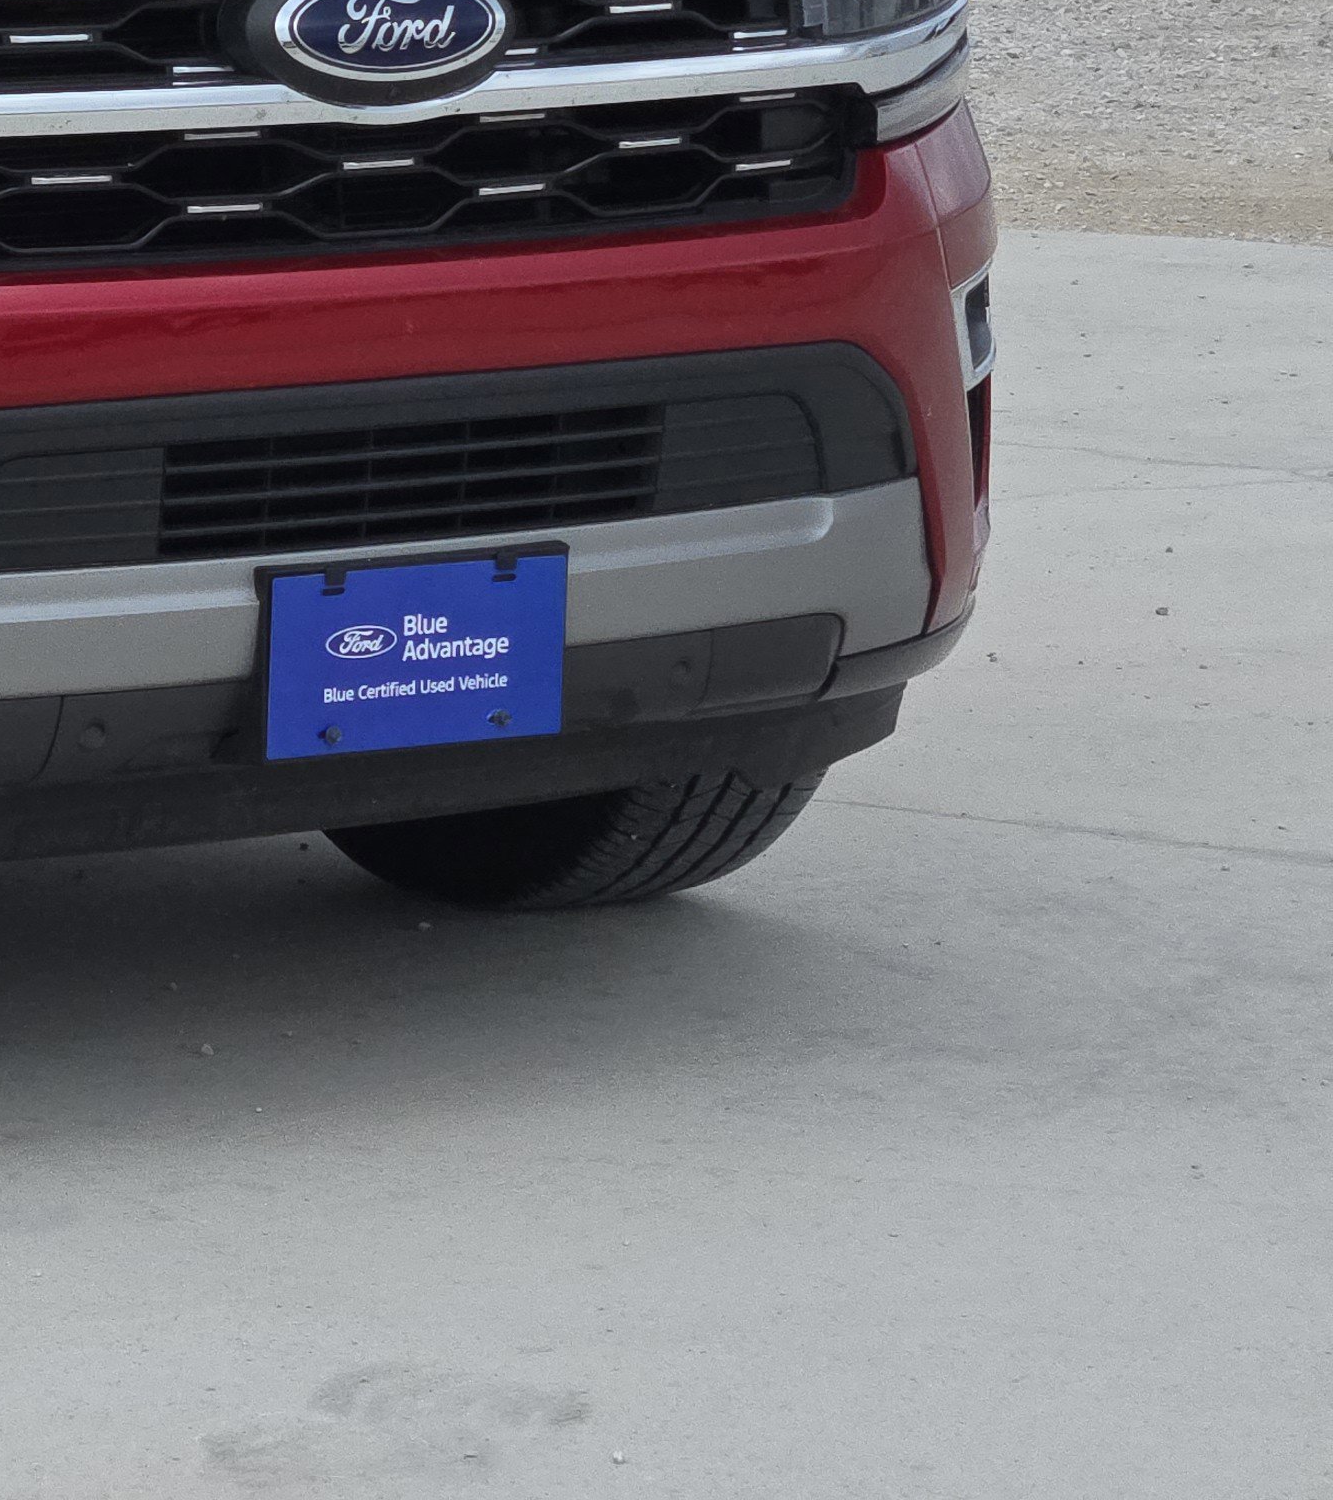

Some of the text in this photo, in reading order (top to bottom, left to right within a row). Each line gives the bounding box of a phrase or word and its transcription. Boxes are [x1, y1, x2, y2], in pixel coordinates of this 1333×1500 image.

[404, 614, 448, 636] Blue
[339, 630, 385, 655] Ford
[402, 634, 510, 662] Advantage
[323, 672, 508, 703] Blue Certified Used Vehicle
